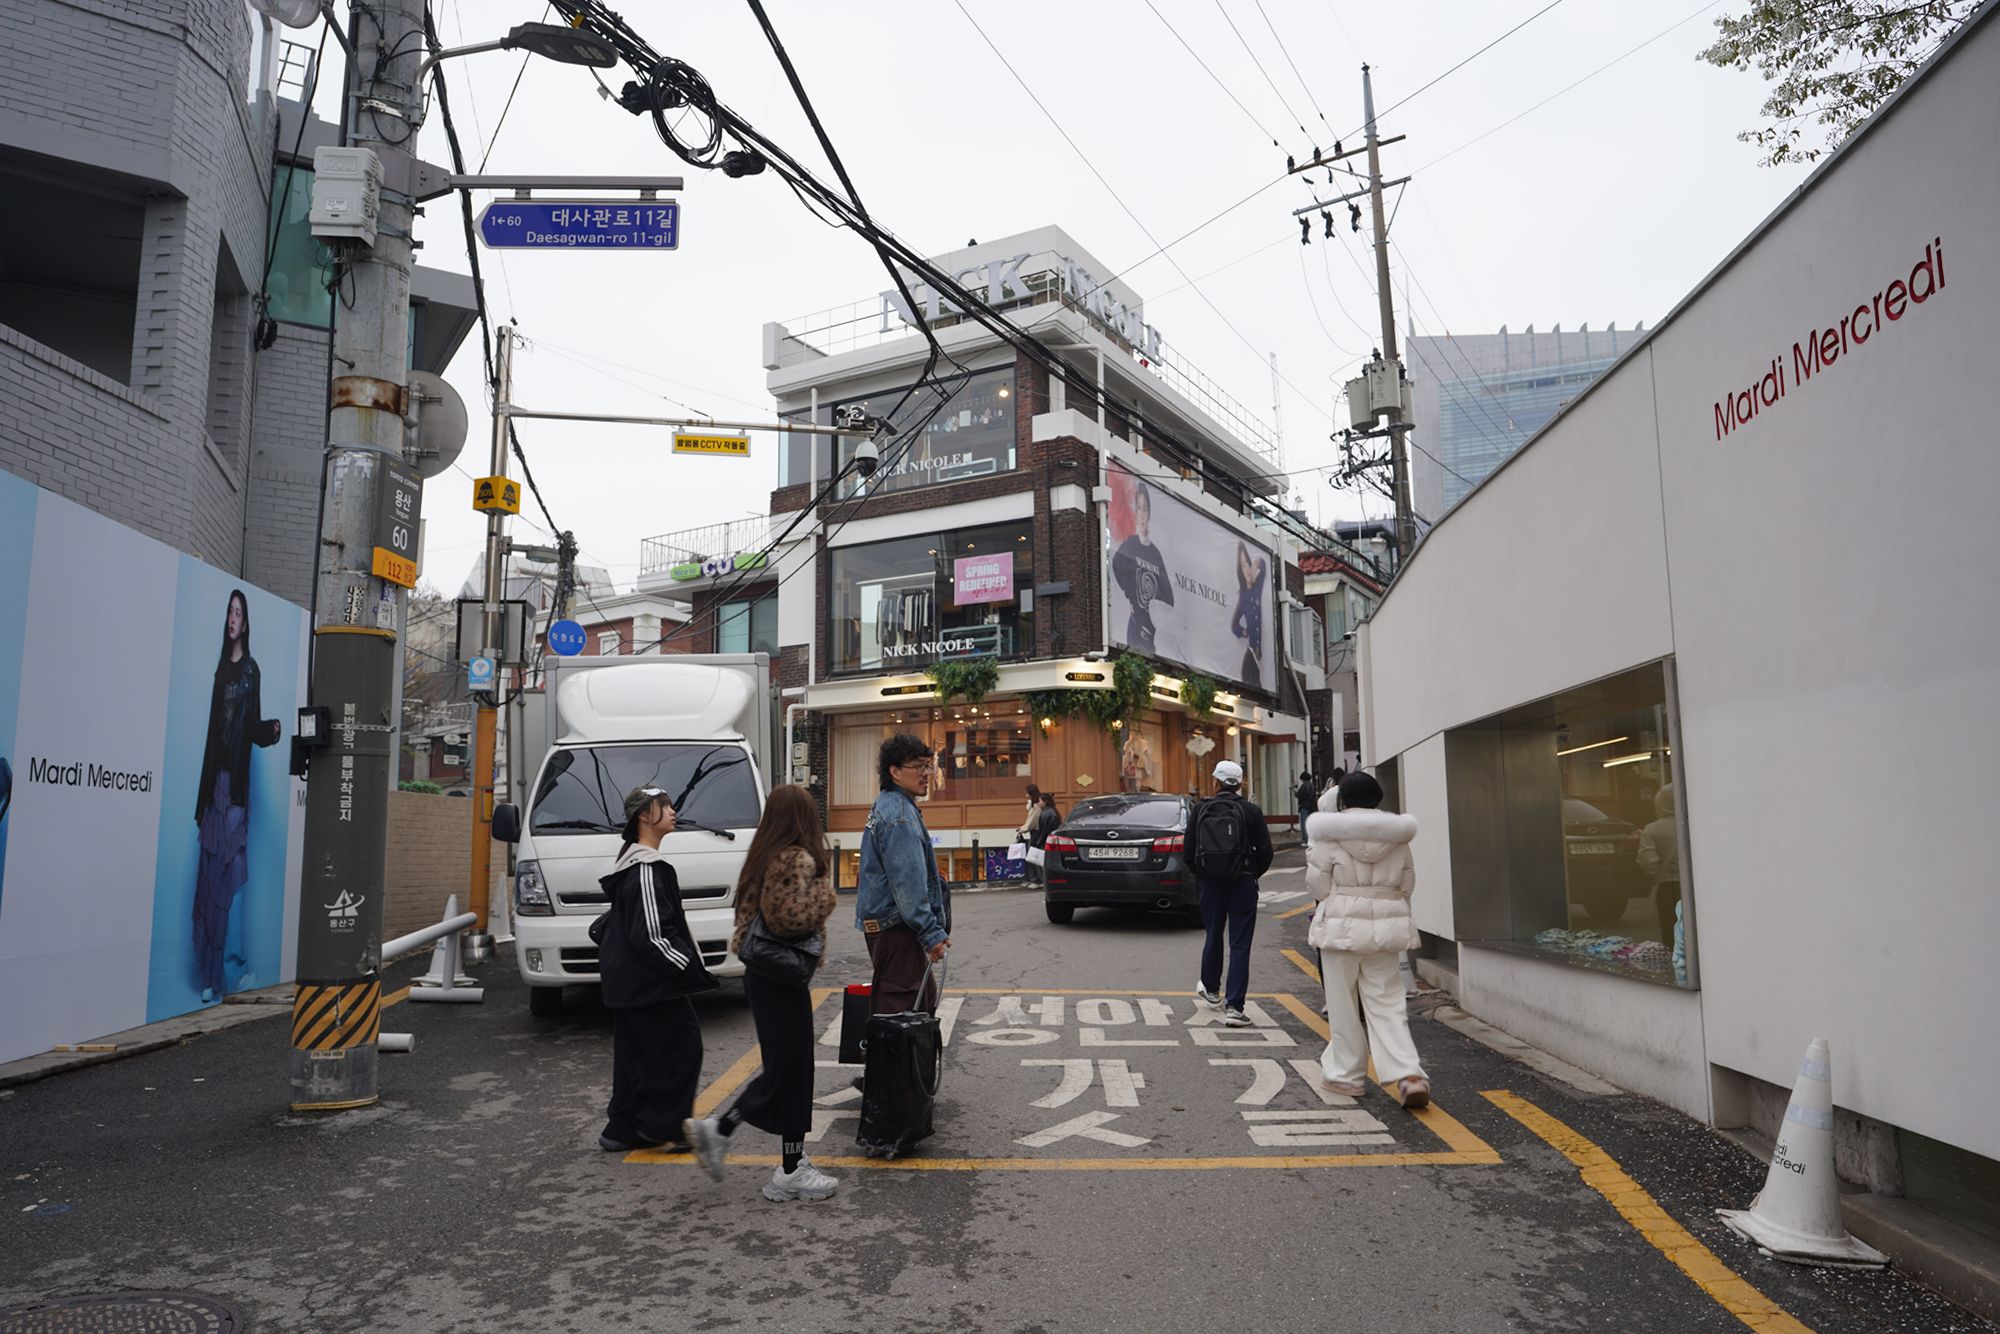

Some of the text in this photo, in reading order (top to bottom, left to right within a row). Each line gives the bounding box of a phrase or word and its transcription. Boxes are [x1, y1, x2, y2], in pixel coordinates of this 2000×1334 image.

[507, 216, 522, 227] 60
[551, 208, 673, 228] 대사관로11길
[526, 231, 672, 246] Daesagwan-ro 11-gil
[879, 253, 1163, 368] NICK NICOLE
[1713, 236, 1946, 442] Mardi Mercredi
[701, 440, 722, 449] CCTV
[873, 453, 962, 479] NICK NICOLE
[395, 489, 412, 513] 용산
[392, 525, 408, 550] 60
[388, 561, 402, 580] 112
[702, 557, 733, 578] CU
[965, 563, 1000, 578] SPRING
[1174, 572, 1227, 608] NICK NICOLE
[883, 637, 975, 658] NICK NICOLE
[28, 757, 153, 793] Mardi Mercredi
[1113, 848, 1135, 857] 9268
[329, 918, 356, 928] 용산구
[1773, 1154, 1806, 1175] credi
